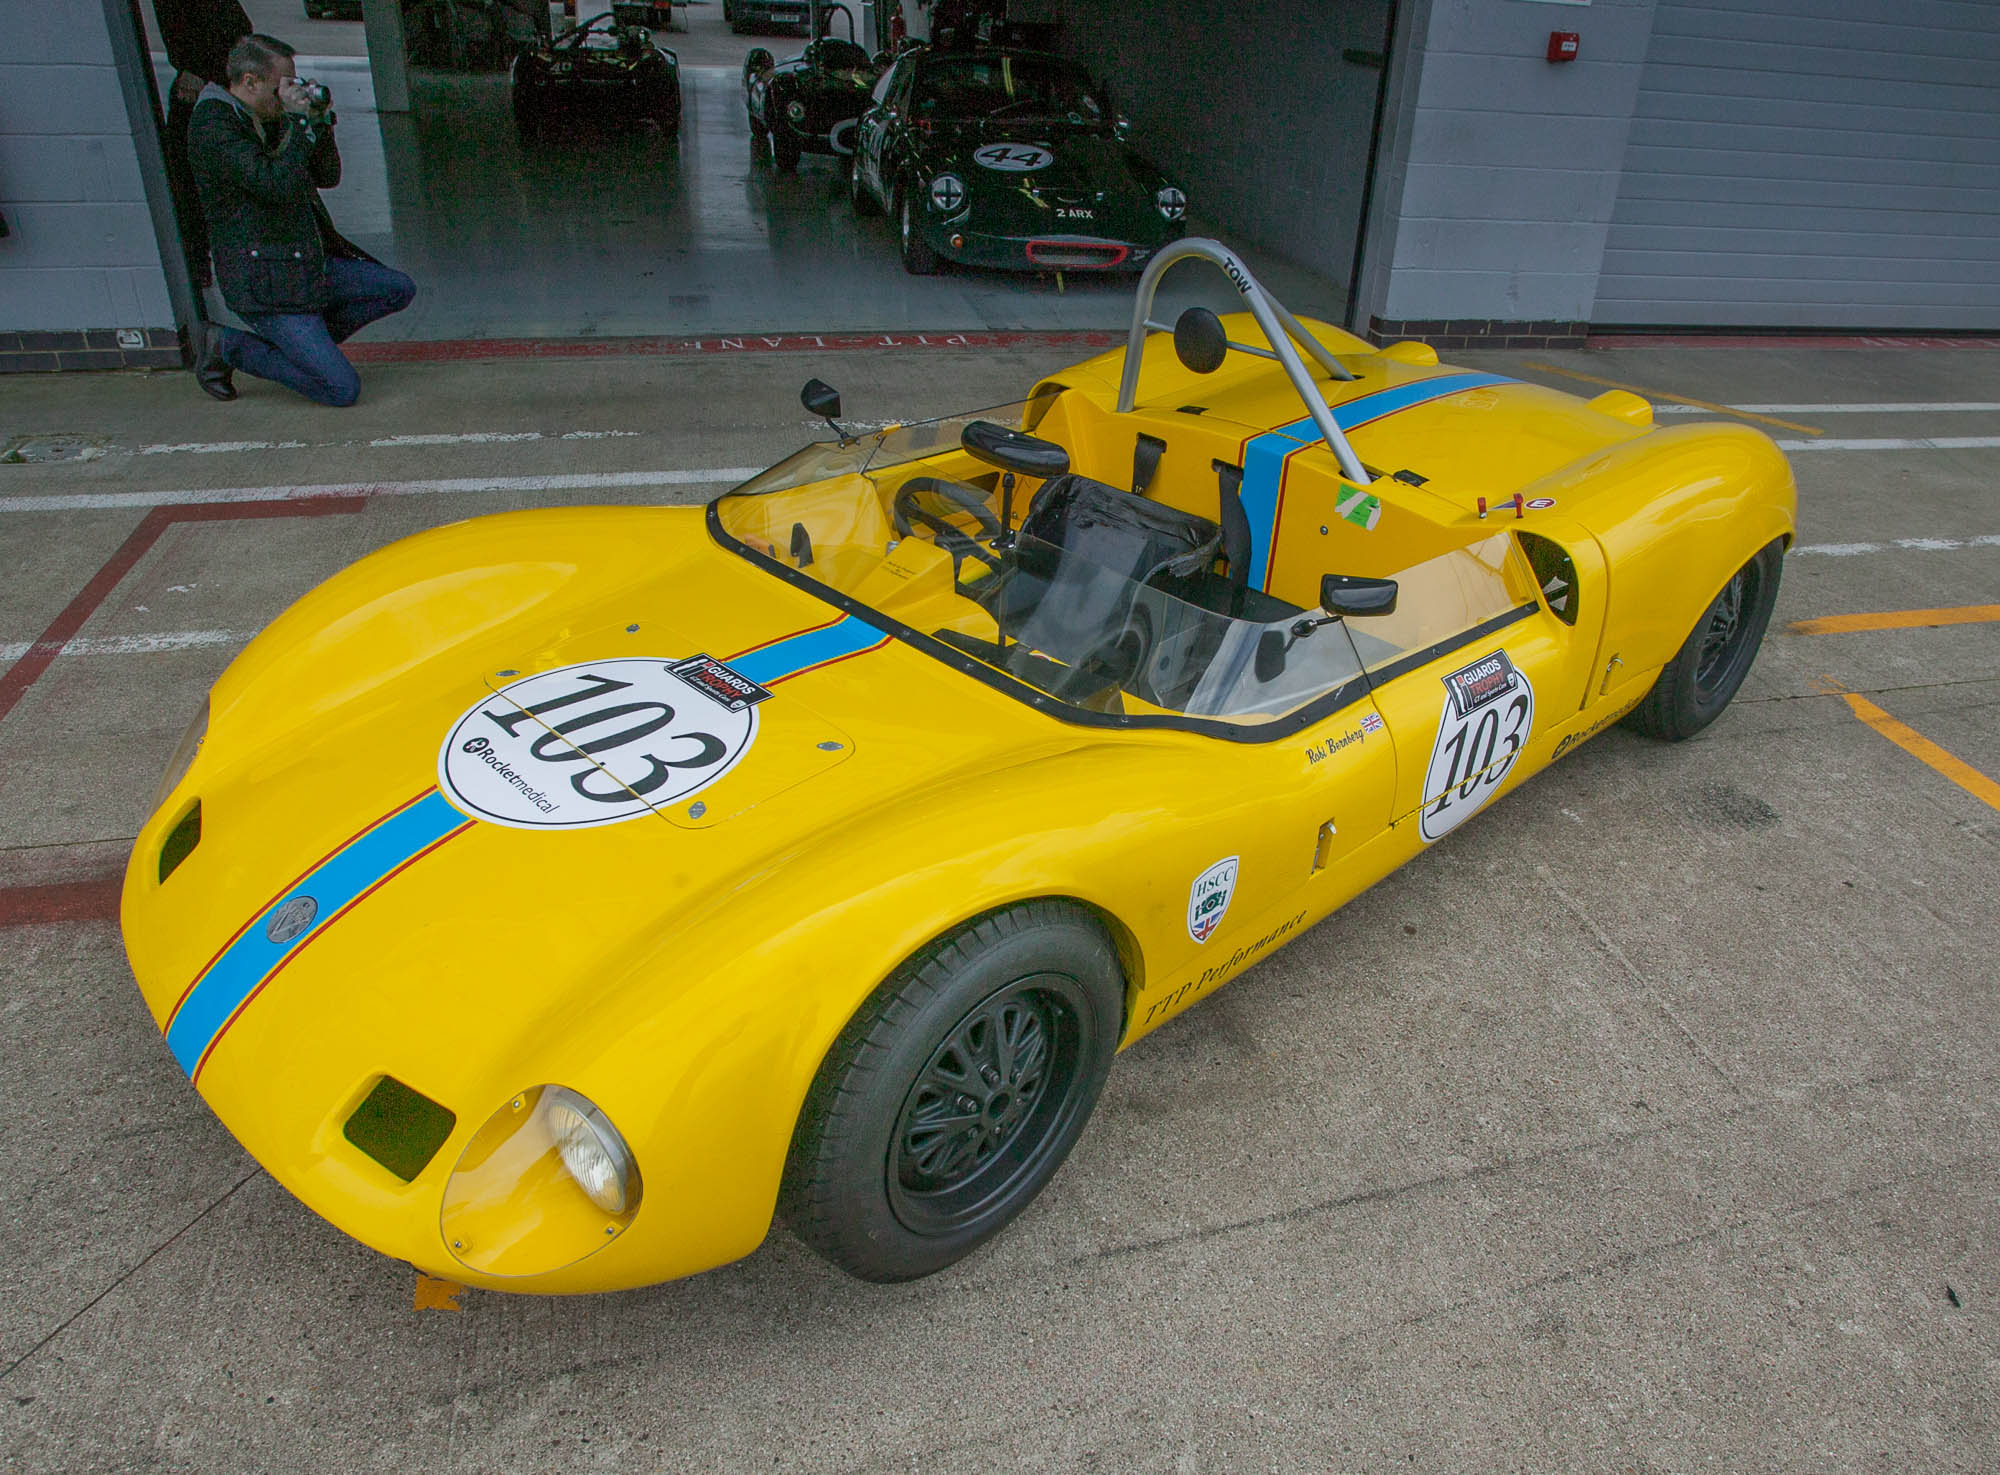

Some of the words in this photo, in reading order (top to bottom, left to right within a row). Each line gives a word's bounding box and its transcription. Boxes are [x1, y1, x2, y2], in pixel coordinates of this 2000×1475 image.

[981, 147, 1043, 167] 44
[1055, 208, 1066, 218] 2
[1068, 208, 1094, 219] ARX
[1223, 256, 1253, 294] TOW
[696, 670, 744, 698] TROPHY
[707, 666, 756, 695] GUARDS
[1463, 658, 1502, 685] GUARDS
[1468, 669, 1505, 696] TROPHY
[481, 673, 728, 803] 103
[1426, 693, 1529, 820] 103
[477, 746, 561, 815] Rocketmedical
[1197, 865, 1234, 898] HSCC
[1144, 981, 1193, 1025] TTP
[1194, 909, 1308, 992] Performance
